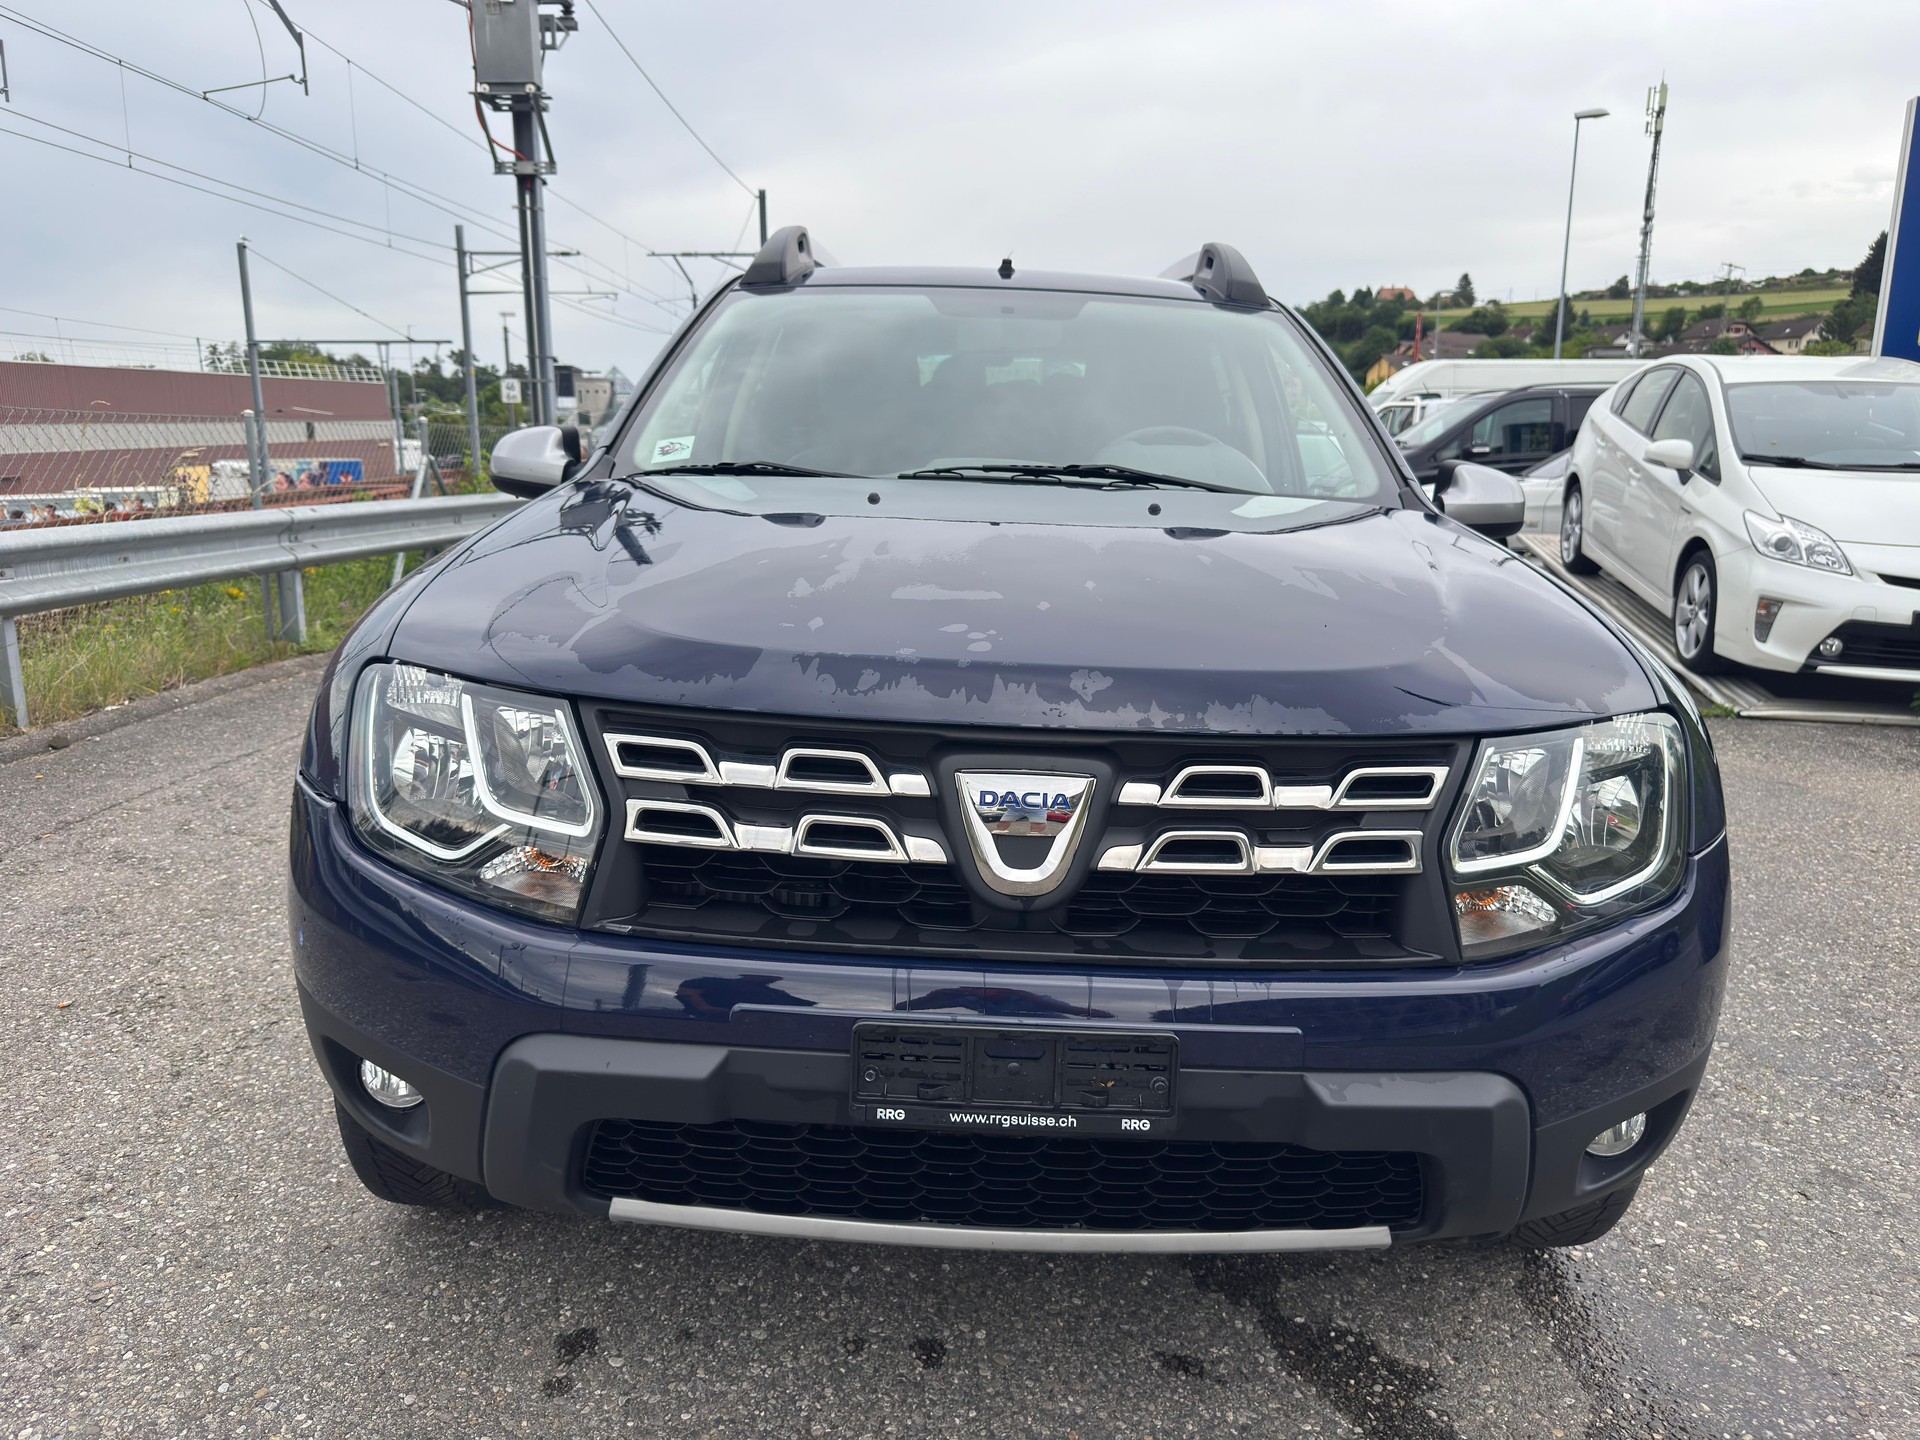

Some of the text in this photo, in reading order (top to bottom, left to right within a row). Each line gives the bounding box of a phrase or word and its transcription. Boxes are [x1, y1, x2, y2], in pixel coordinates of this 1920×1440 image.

[979, 790, 1072, 810] DACIA
[876, 1108, 1151, 1131] RRG www.rrgsuisse.ch RRG
